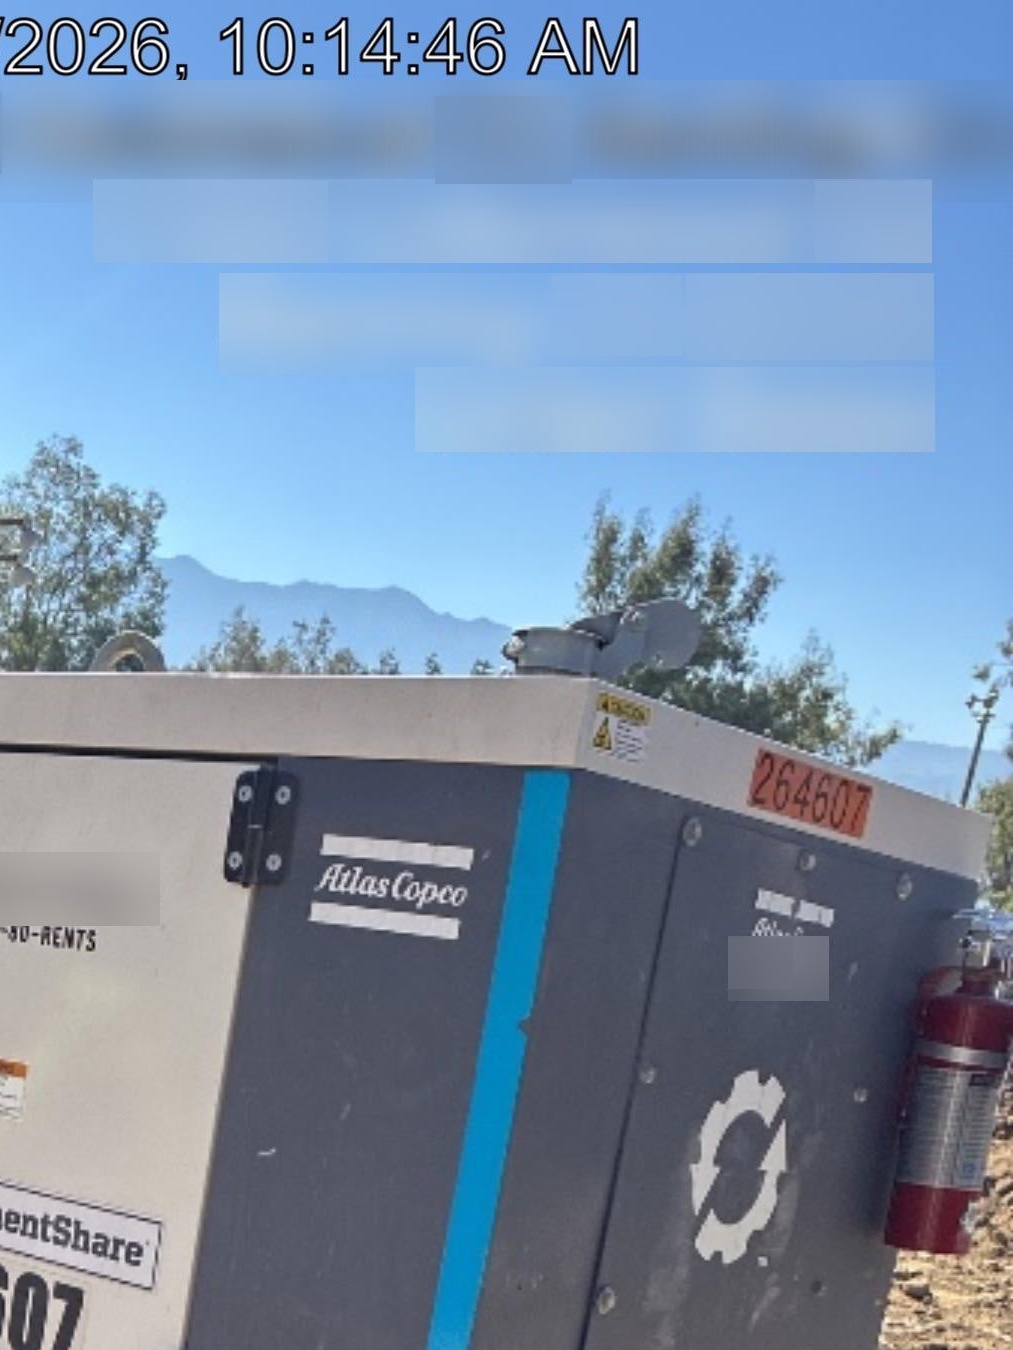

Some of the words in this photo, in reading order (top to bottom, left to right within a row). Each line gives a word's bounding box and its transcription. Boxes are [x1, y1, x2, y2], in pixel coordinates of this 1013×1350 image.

[750, 751, 874, 833] 264607
[314, 863, 390, 898] Atlas
[391, 870, 469, 910] Copco
